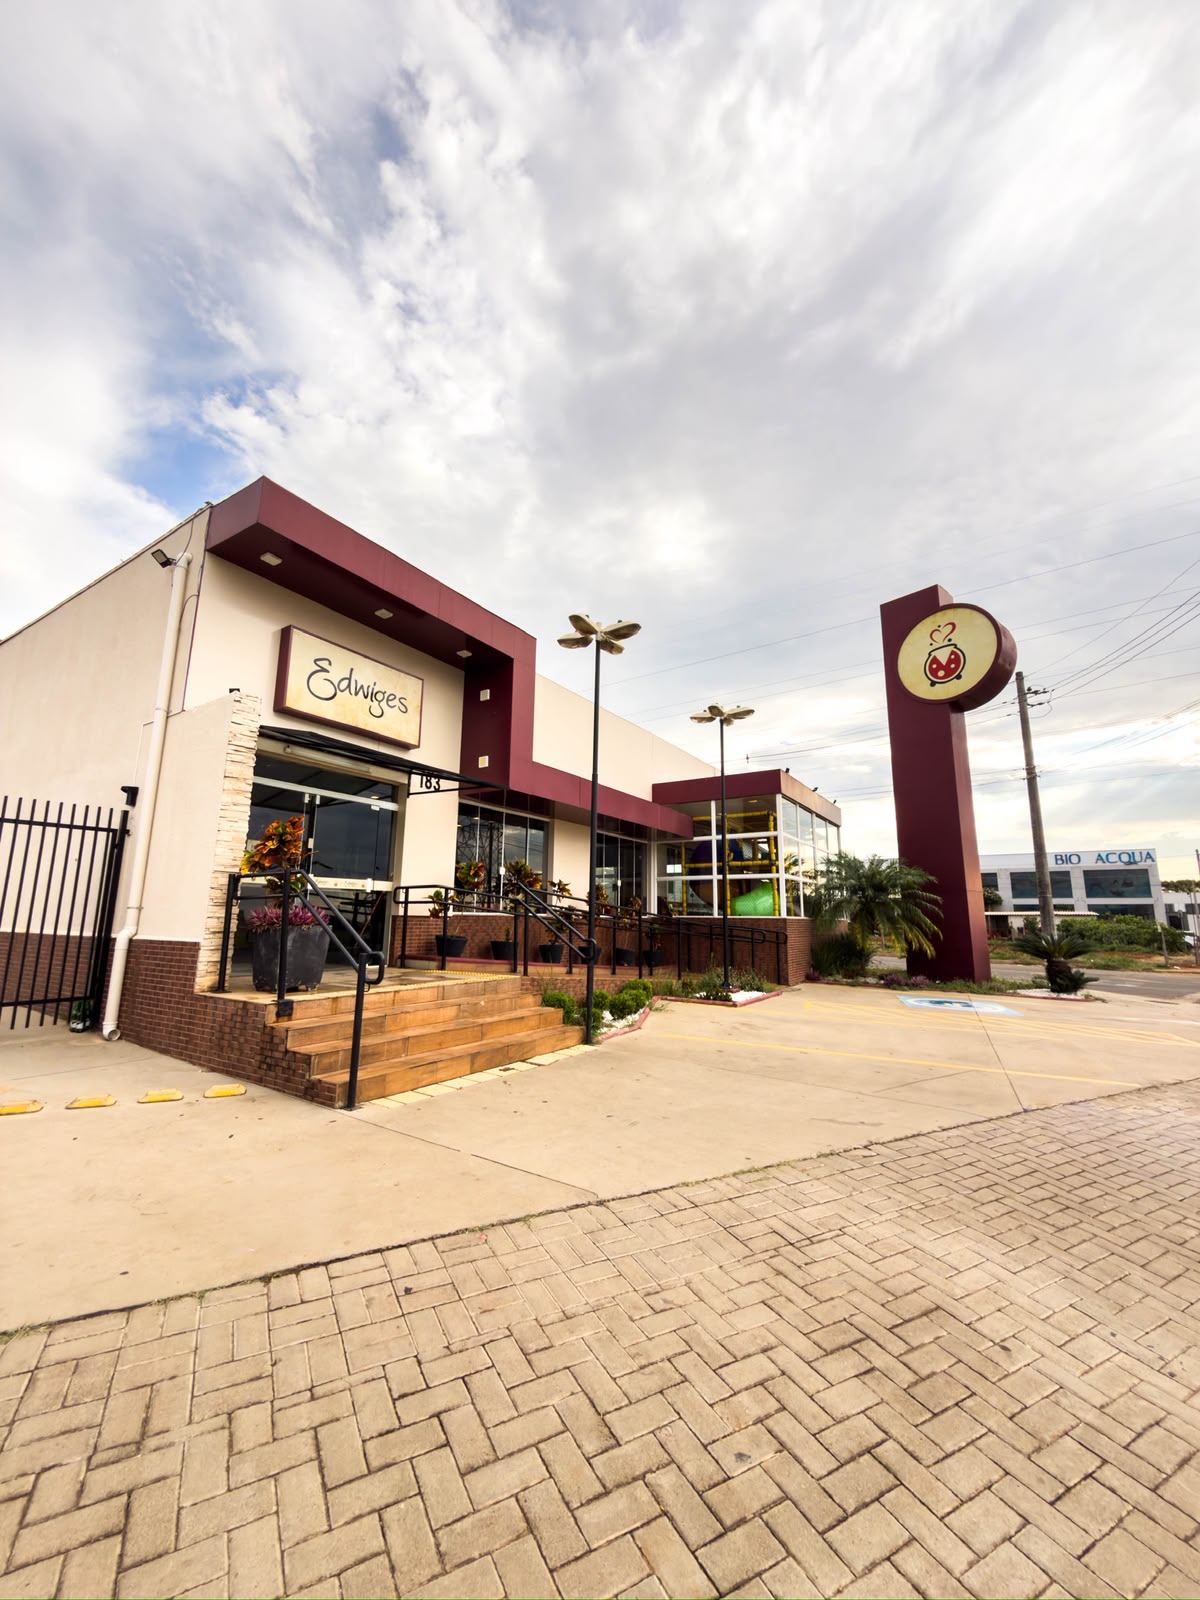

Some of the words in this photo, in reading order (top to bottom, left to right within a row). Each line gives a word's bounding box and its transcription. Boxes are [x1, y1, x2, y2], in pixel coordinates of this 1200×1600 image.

[307, 658, 408, 718] Edwiges
[419, 775, 441, 791] 183
[1054, 853, 1081, 865] BIO
[1095, 851, 1156, 865] ACQUA
